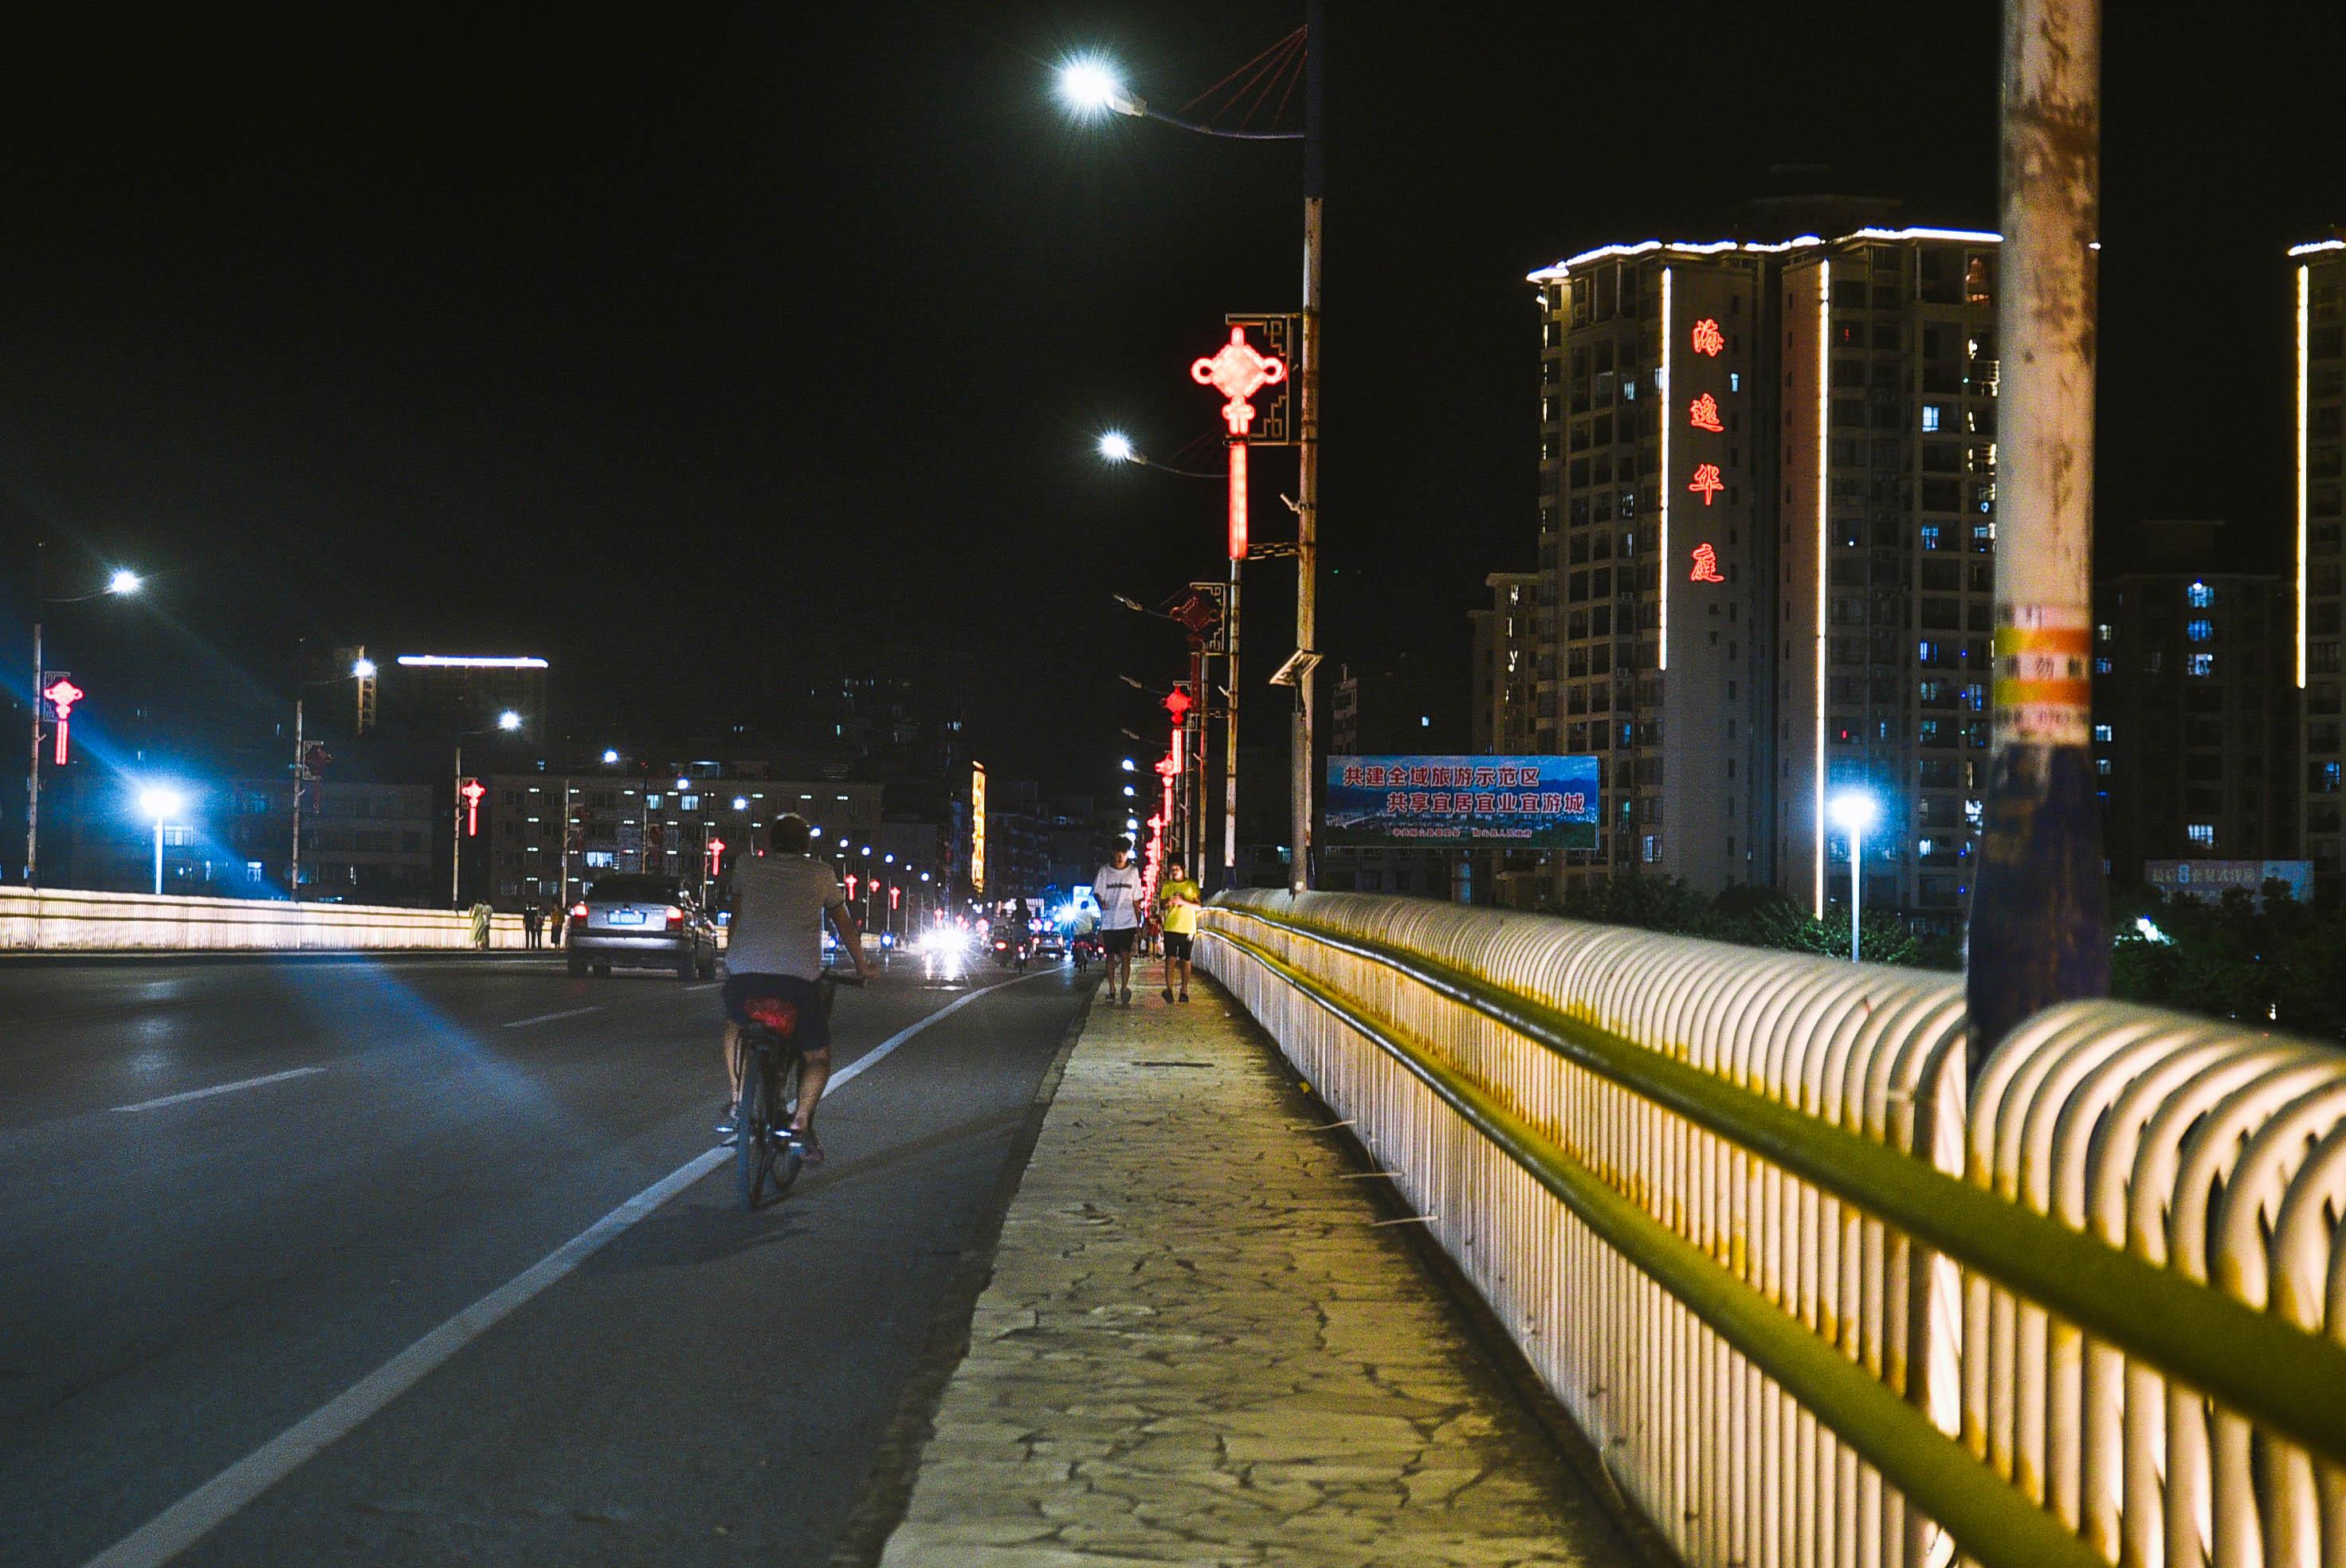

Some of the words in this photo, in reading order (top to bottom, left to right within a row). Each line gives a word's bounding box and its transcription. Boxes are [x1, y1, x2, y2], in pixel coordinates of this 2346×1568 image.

[1689, 319, 1724, 582] 海逸华庭
[1344, 766, 1540, 788] 共建全域旅游示范区
[1387, 792, 1585, 813] 共享宜居宜业宜游城
